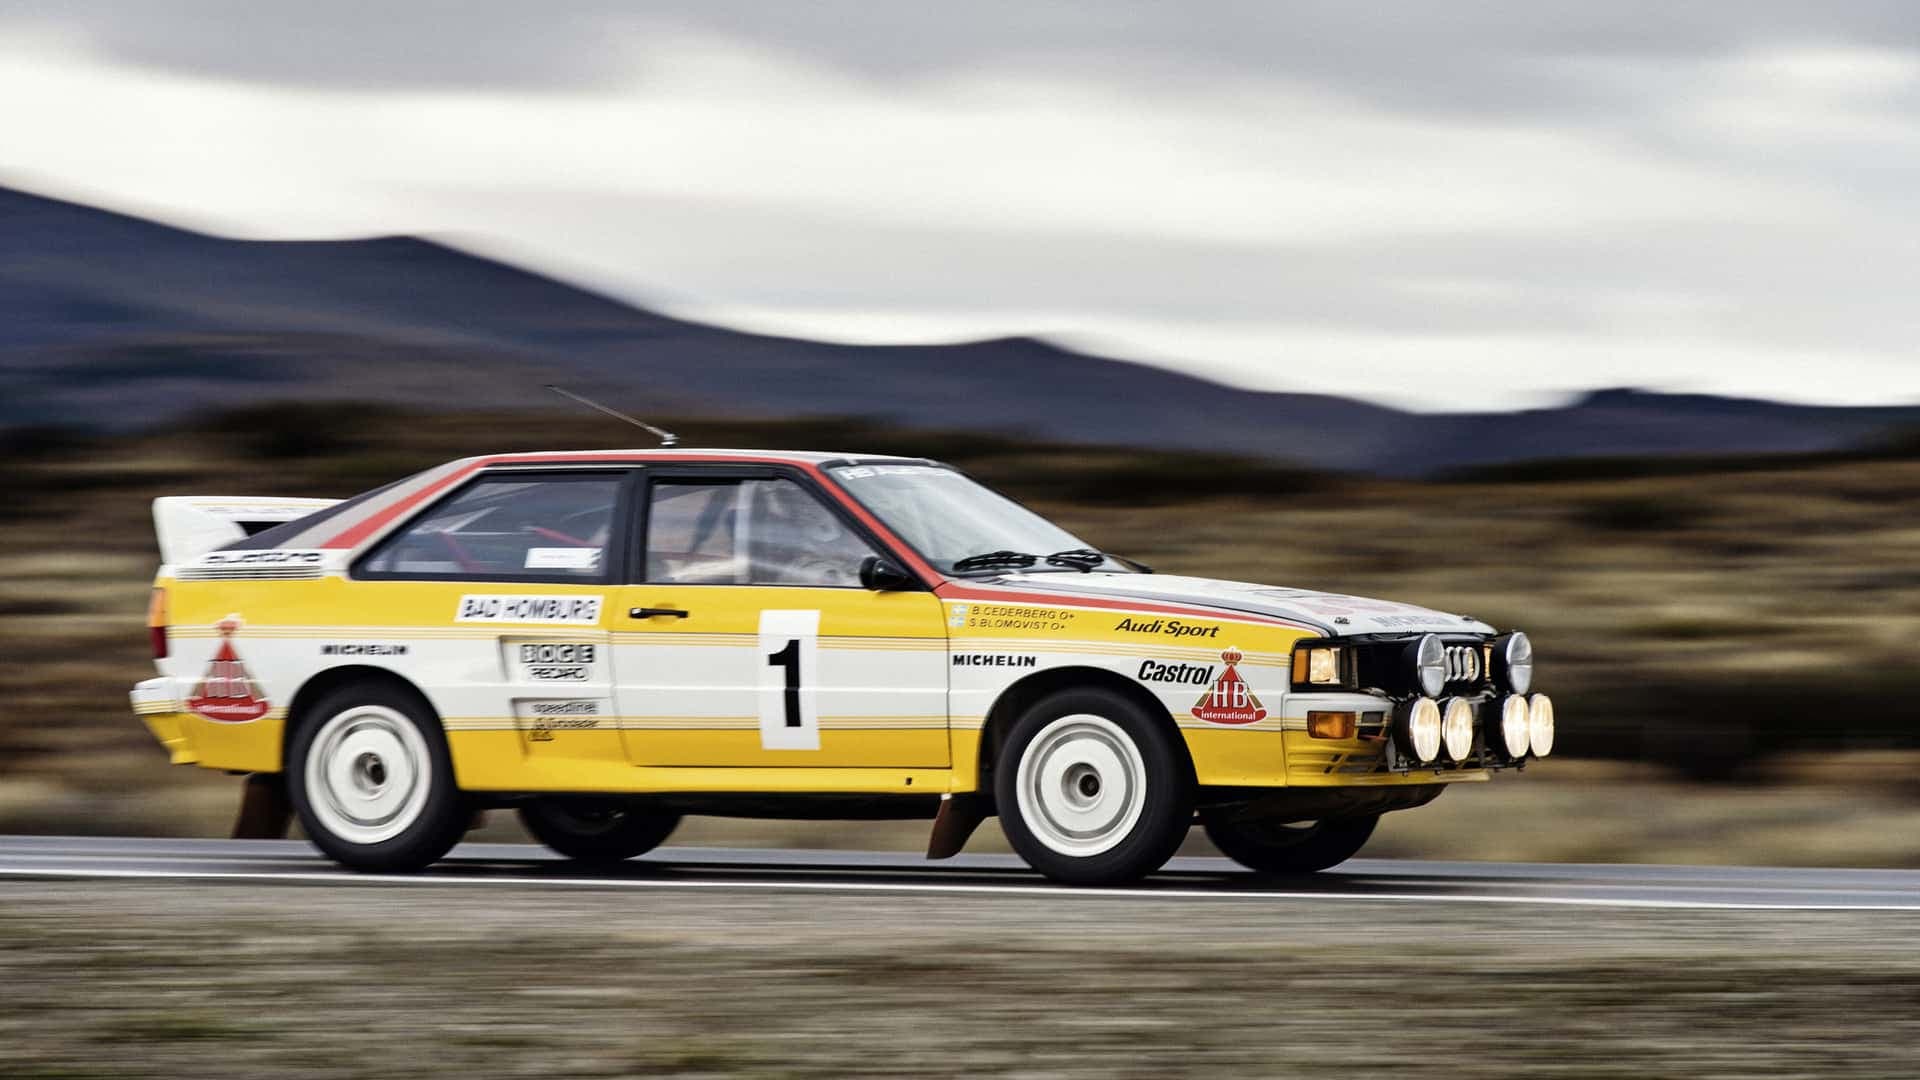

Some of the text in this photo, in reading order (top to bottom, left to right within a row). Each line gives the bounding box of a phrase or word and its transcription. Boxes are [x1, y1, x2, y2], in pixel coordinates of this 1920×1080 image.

[463, 598, 597, 620] BAD HOMBURG
[1115, 618, 1220, 638] Audi Sport
[320, 643, 409, 656] MICHELIN
[952, 653, 1037, 668] MICHELIN
[1137, 659, 1215, 685] Castrol
[768, 639, 802, 728] 1
[1211, 679, 1249, 709] HB
[1201, 710, 1256, 721] international
